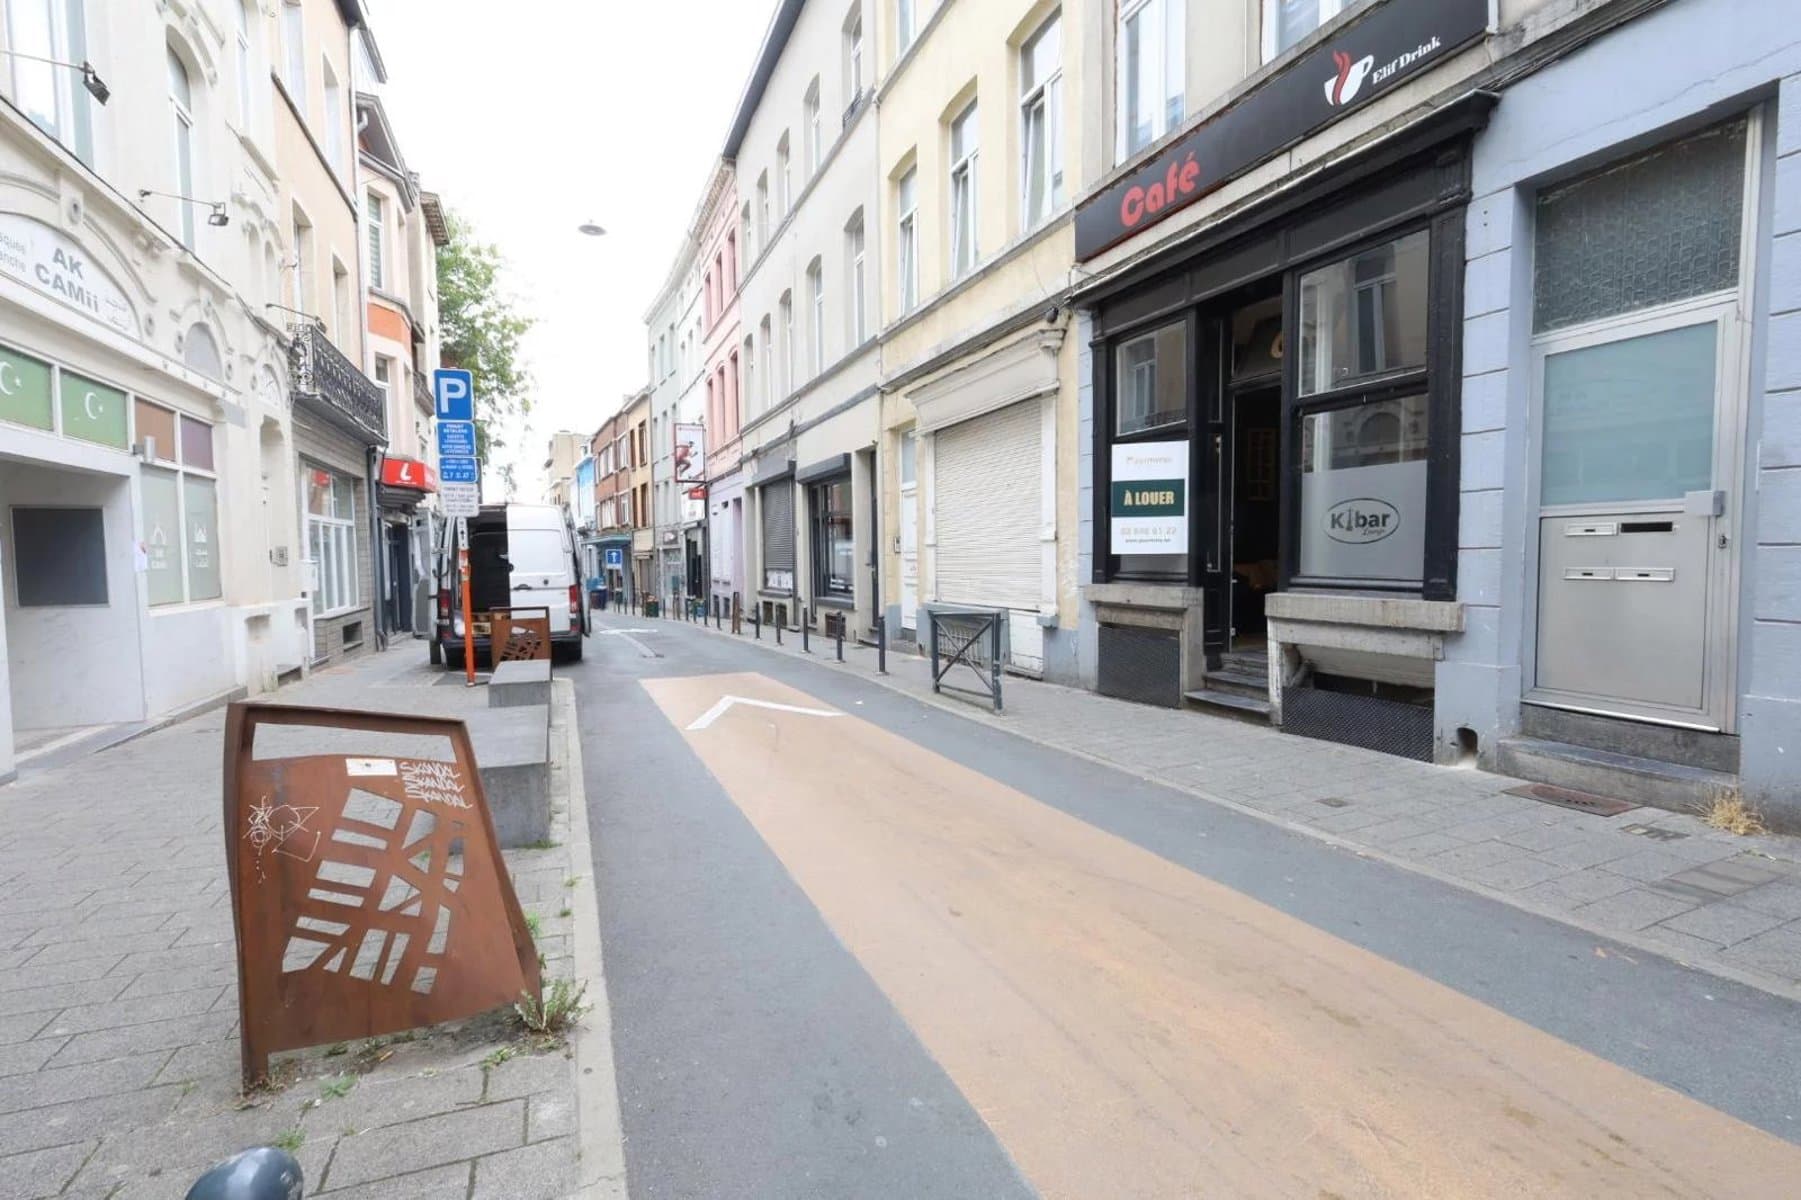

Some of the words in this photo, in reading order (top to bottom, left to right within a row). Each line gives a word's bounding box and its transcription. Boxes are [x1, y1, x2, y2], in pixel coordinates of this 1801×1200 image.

[1400, 36, 1441, 69] Drink
[1121, 152, 1200, 227] Café
[52, 247, 84, 280] AK
[439, 377, 467, 413] P
[1135, 491, 1175, 506] LOUER
